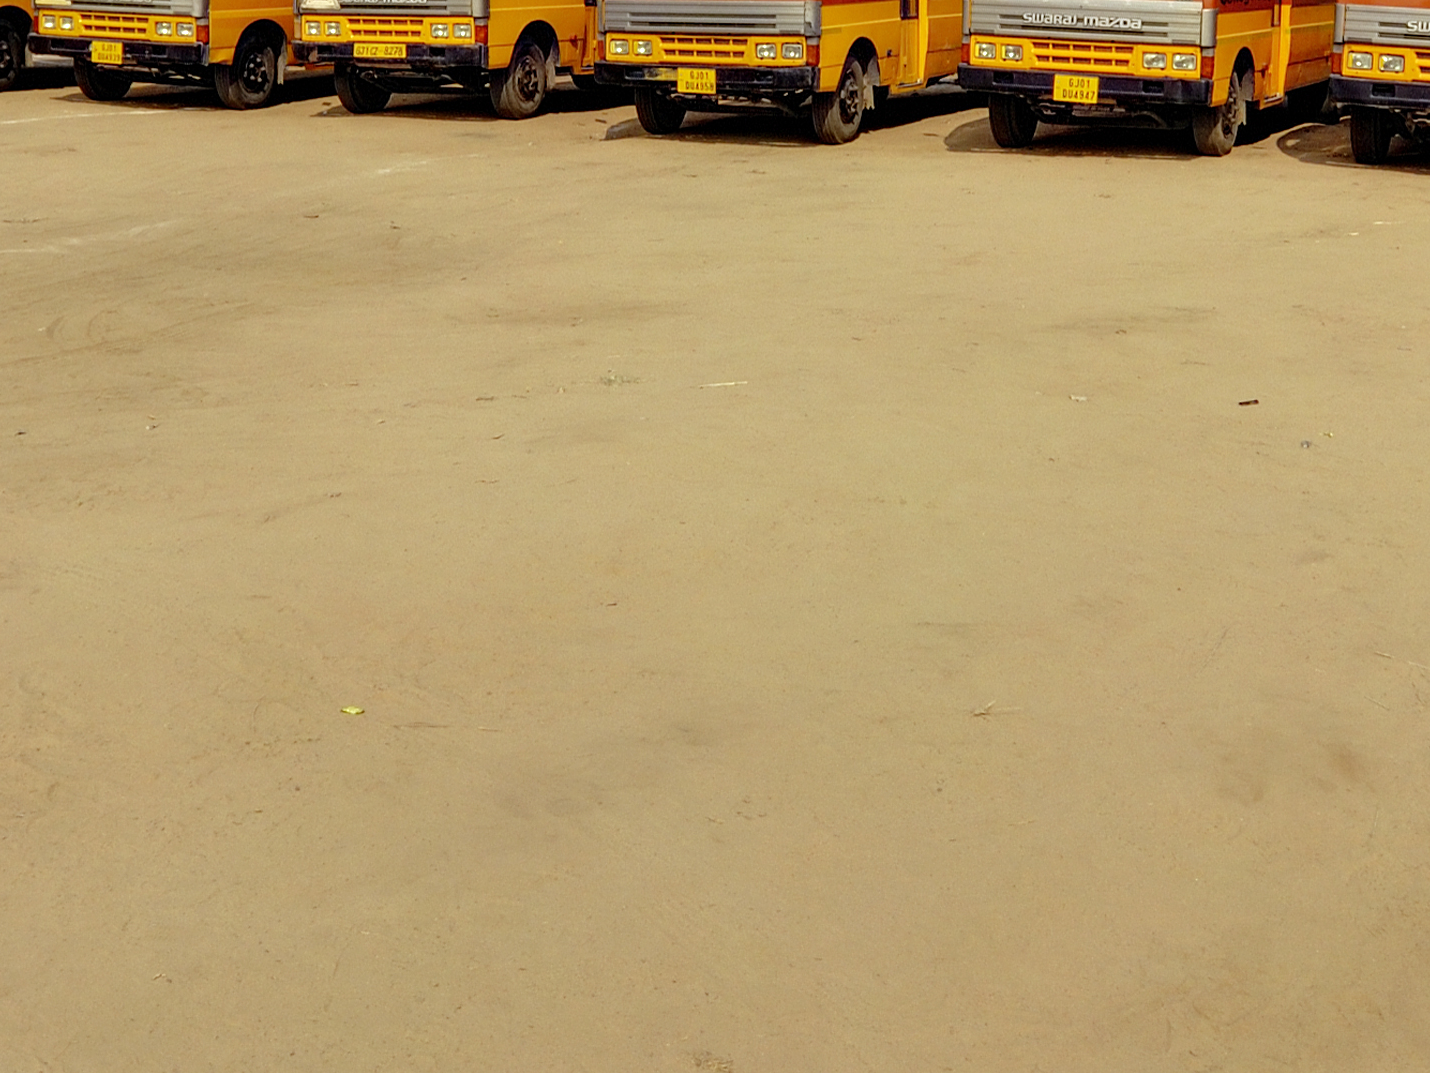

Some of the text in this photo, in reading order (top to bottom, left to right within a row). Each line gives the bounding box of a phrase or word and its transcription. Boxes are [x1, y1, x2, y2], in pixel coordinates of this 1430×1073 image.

[690, 70, 709, 80] GJ01
[1068, 78, 1090, 88] GJ01
[1062, 88, 1096, 100] DU4947
